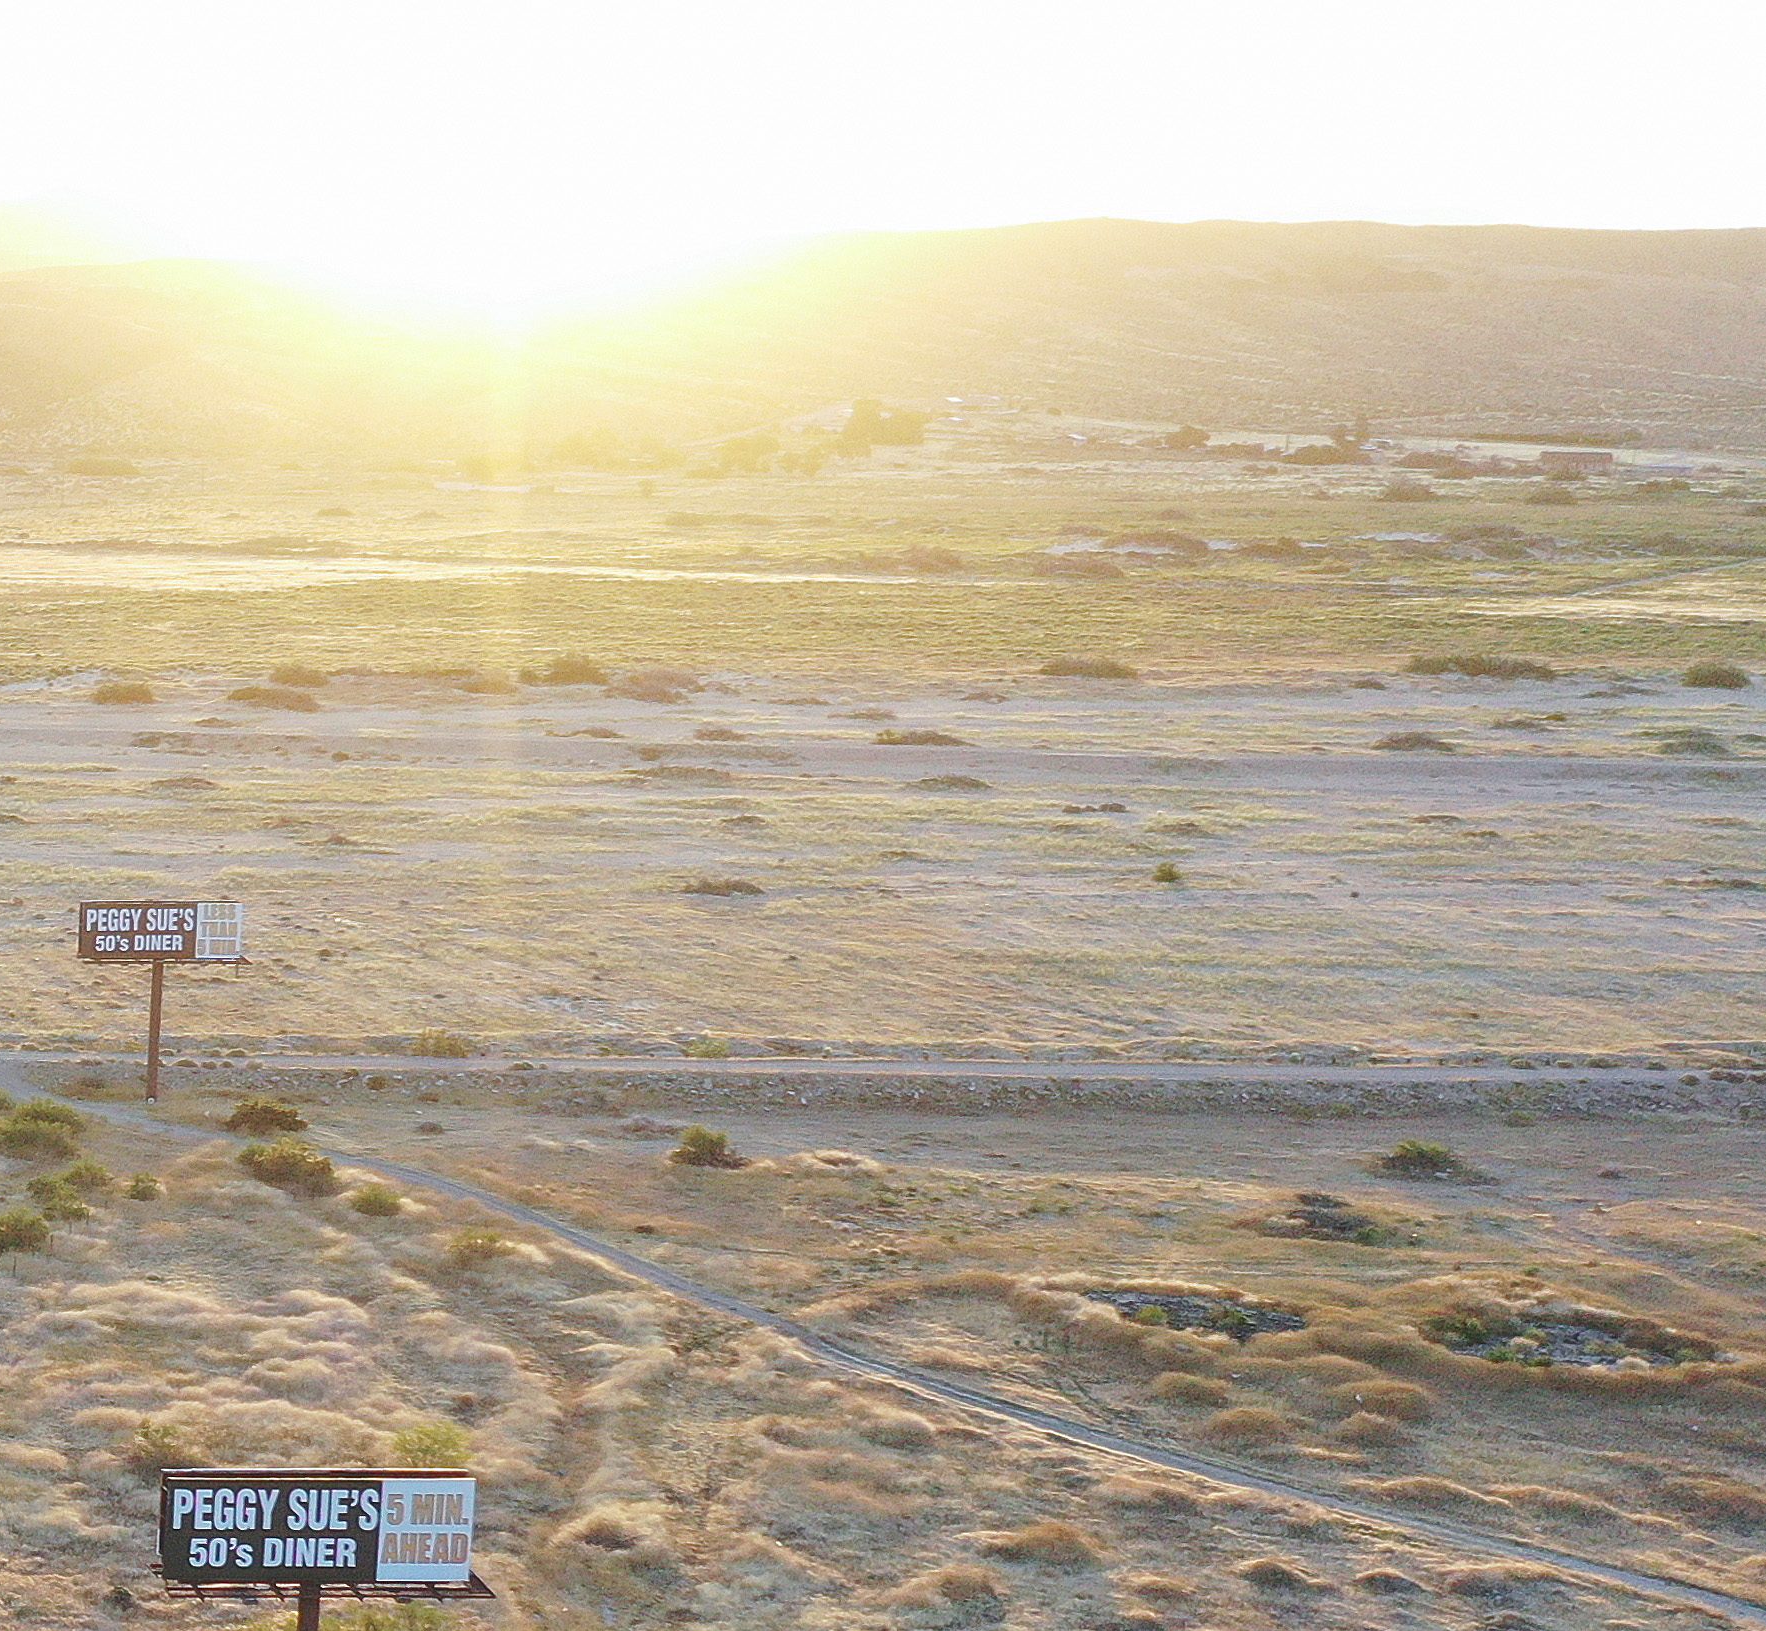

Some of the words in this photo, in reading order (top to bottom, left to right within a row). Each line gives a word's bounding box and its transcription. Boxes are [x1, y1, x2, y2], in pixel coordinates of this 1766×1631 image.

[86, 908, 142, 932] PEGGY
[146, 908, 194, 931] SUE'S
[95, 935, 129, 951] 50's
[134, 935, 183, 951] DINER
[172, 1488, 280, 1531] PEGGY
[287, 1487, 380, 1531] SUE'S
[386, 1493, 404, 1526] 5
[410, 1493, 468, 1526] MIN.
[188, 1537, 253, 1568] 50's
[263, 1537, 357, 1568] DINER
[380, 1532, 469, 1564] AHEAD
